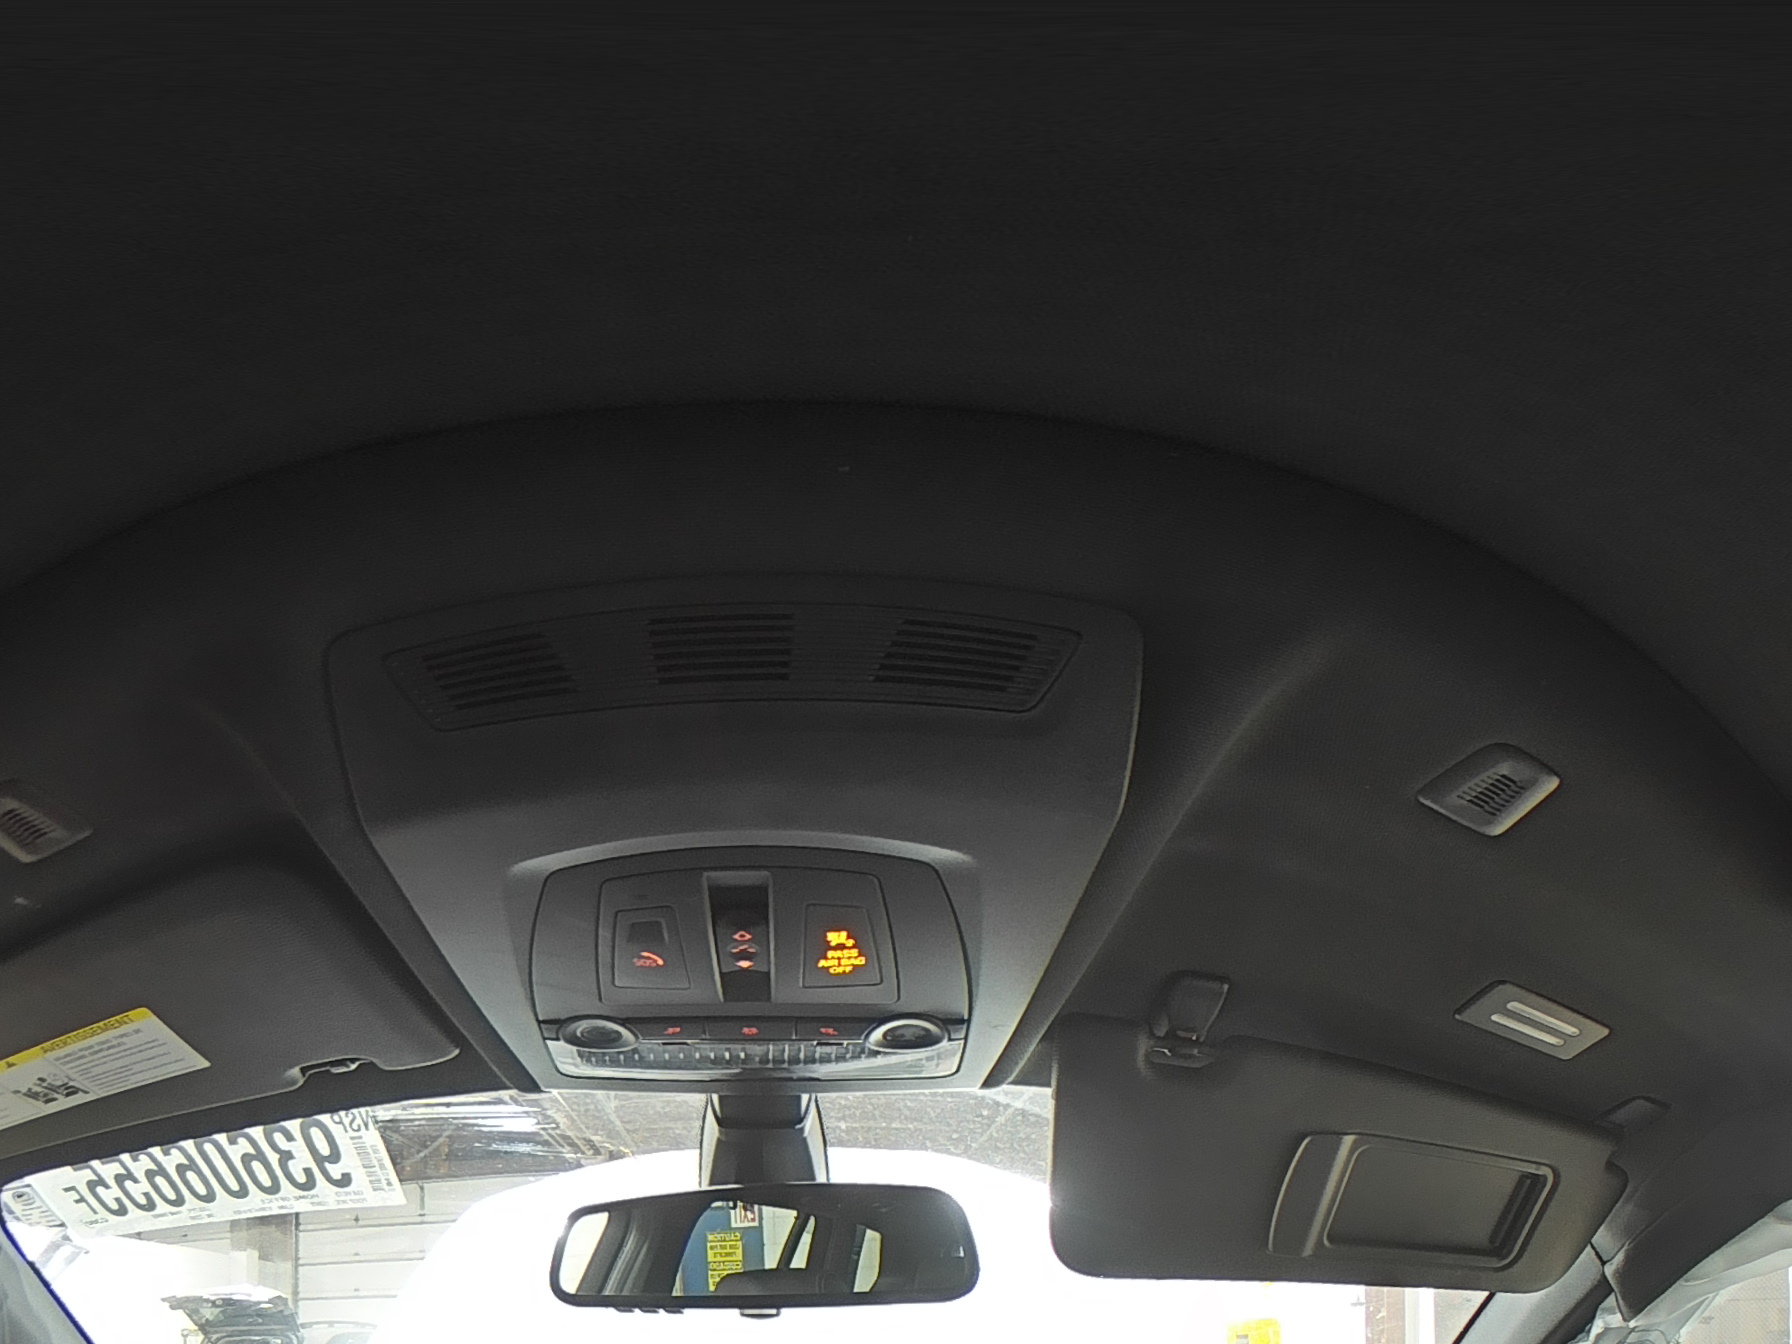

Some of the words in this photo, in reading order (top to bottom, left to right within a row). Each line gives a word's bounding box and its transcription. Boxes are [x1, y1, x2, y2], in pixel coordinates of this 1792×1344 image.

[827, 949, 859, 958] PASS
[633, 957, 656, 967] SOS
[818, 958, 839, 967] AIR
[840, 957, 866, 966] BAG
[829, 966, 853, 974] OFF
